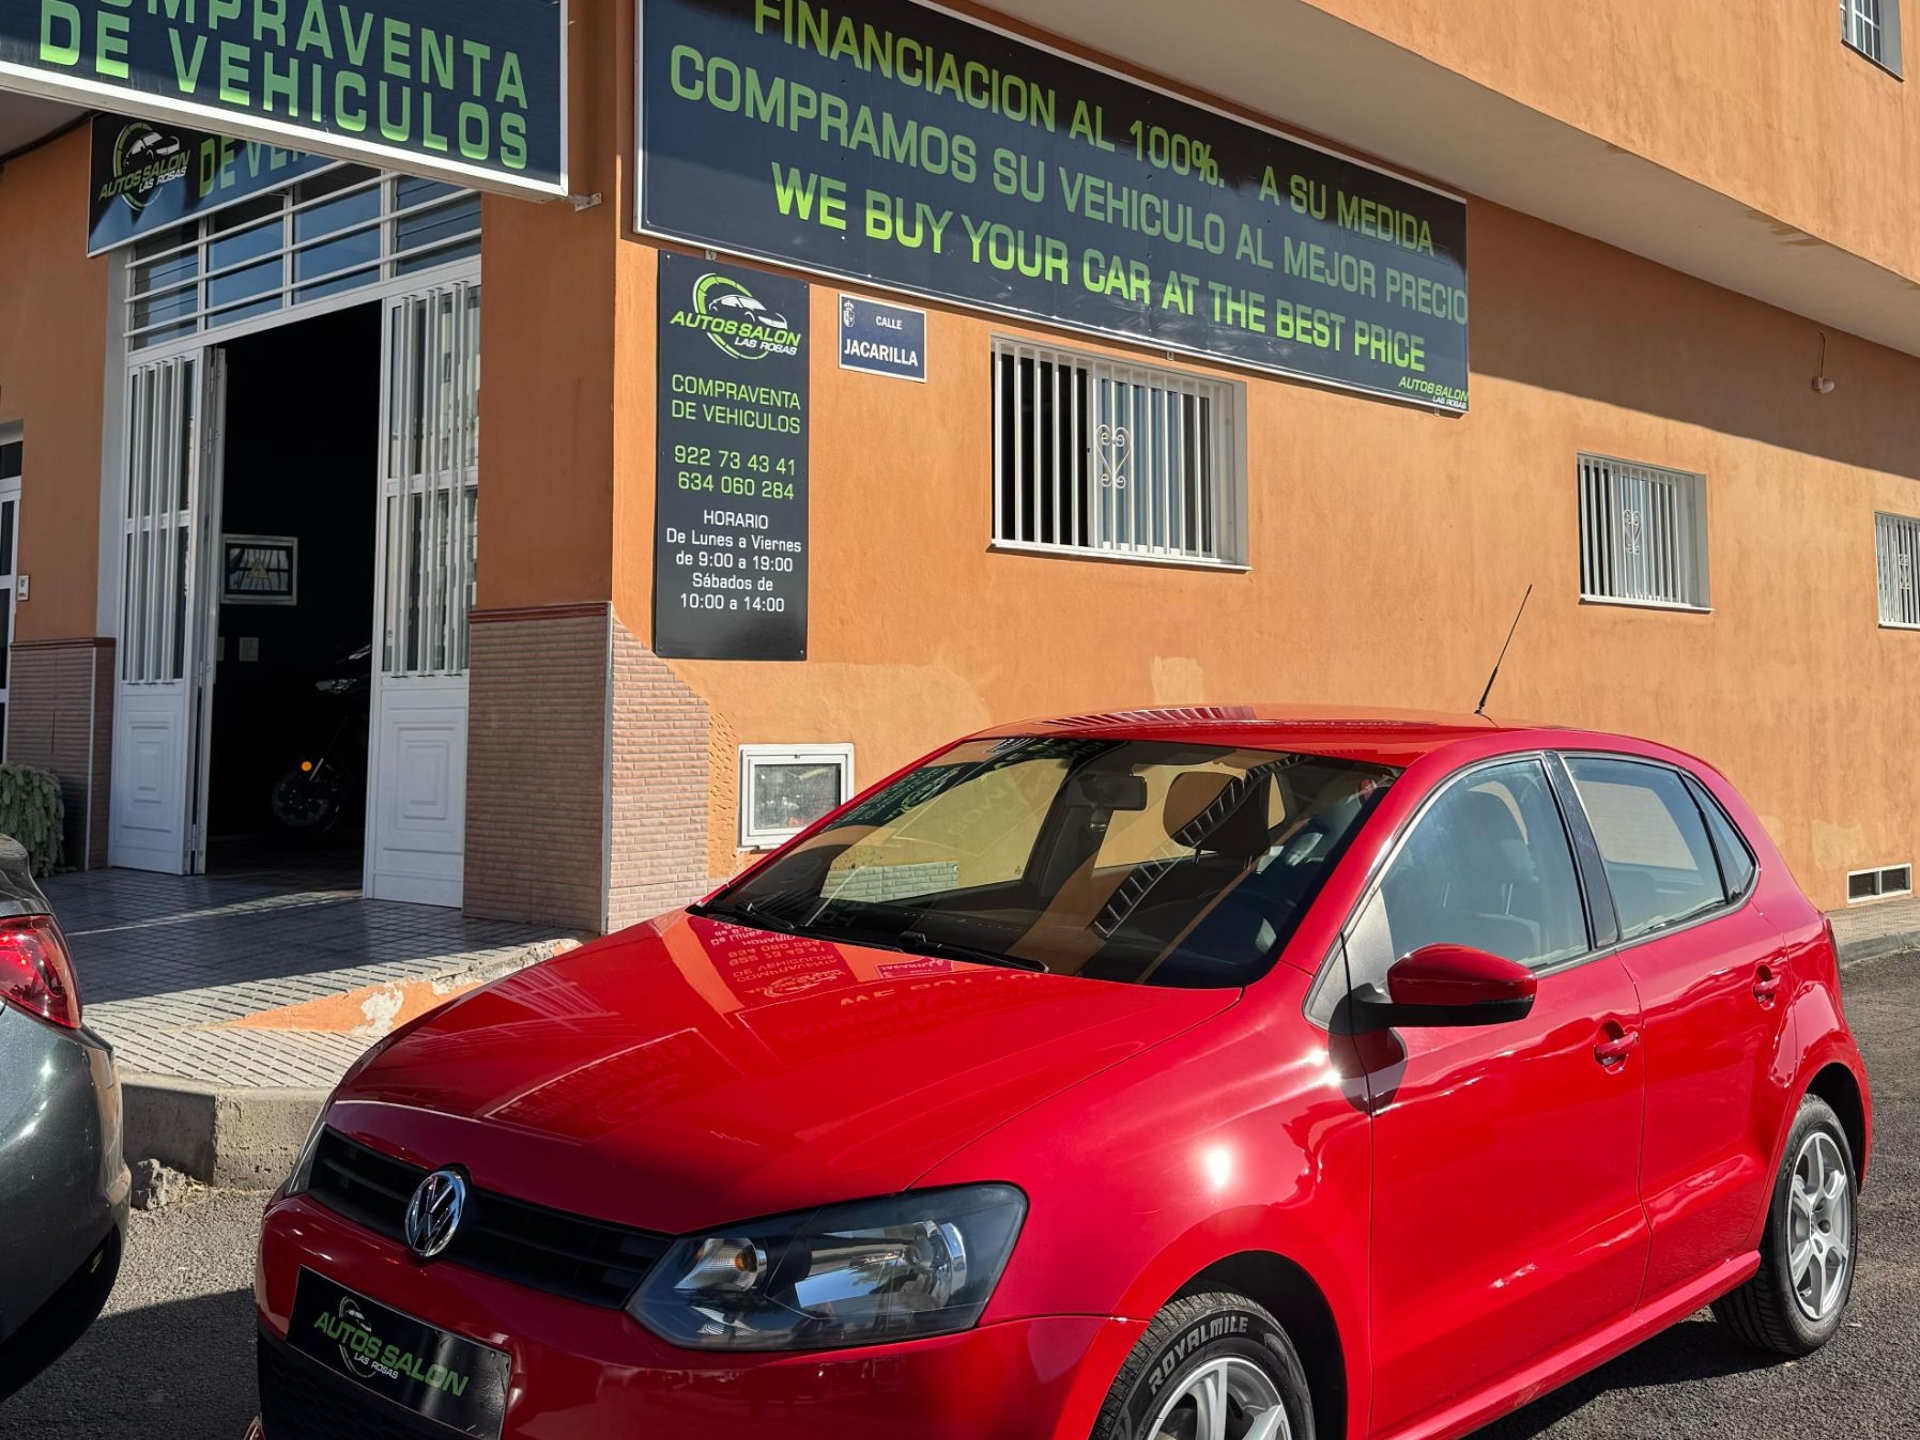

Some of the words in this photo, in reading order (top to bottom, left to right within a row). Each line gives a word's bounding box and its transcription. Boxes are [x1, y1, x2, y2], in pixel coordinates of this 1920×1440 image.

[40, 0, 130, 79] DE
[168, 27, 528, 170] VEHICULOS
[754, 0, 1056, 132] FINANCIACION
[1068, 99, 1116, 152] AL
[1129, 120, 1225, 188] 100%.
[1259, 164, 1280, 206] A
[1289, 173, 1327, 221] SU
[1337, 190, 1435, 257] MEDIDA
[138, 177, 154, 194] LAS
[157, 165, 188, 186] ROSAS
[200, 135, 236, 198] DE
[670, 44, 977, 184] COMPRAMOS
[993, 147, 1045, 202] SU
[1058, 166, 1225, 255] VEHICULO
[1235, 223, 1274, 269] AL
[1283, 235, 1376, 299] MEJOR
[1386, 267, 1468, 325] PRECIO
[771, 161, 847, 231] WE
[865, 189, 953, 255] BUY
[961, 213, 1069, 285] YOUR
[1082, 248, 1150, 305] CAR
[1162, 270, 1200, 315] AT
[1208, 280, 1267, 334] THE
[1276, 298, 1346, 352] BEST
[1354, 320, 1426, 373] PRICE
[875, 315, 903, 331] CALLE
[734, 336, 757, 349] LAS
[759, 340, 798, 356] ROSAS
[844, 338, 919, 367] JACARILLA
[671, 373, 801, 411] COMPRAVENTA
[671, 400, 697, 421] DE
[703, 403, 801, 434] VEHICULOS
[674, 445, 711, 466] 922
[718, 450, 741, 470] 73
[747, 454, 770, 473] 43
[776, 457, 796, 476] 41
[678, 471, 714, 492] 634
[721, 476, 755, 496] 060
[761, 480, 795, 500] 284
[703, 509, 769, 530] HORARIO
[666, 527, 686, 544] De
[691, 529, 734, 547] Lunes
[738, 536, 747, 549] a
[751, 533, 802, 553] Viernes
[675, 550, 693, 566] de
[698, 551, 734, 569] 9:00
[738, 557, 747, 570] a
[752, 555, 794, 573] 19:00
[692, 572, 753, 591] Sábados
[757, 576, 774, 592] de
[680, 592, 725, 609] 10:00
[729, 598, 738, 611] a
[744, 596, 786, 613] 14:00
[353, 1351, 370, 1366] LAS
[371, 1360, 400, 1380] ROSAS
